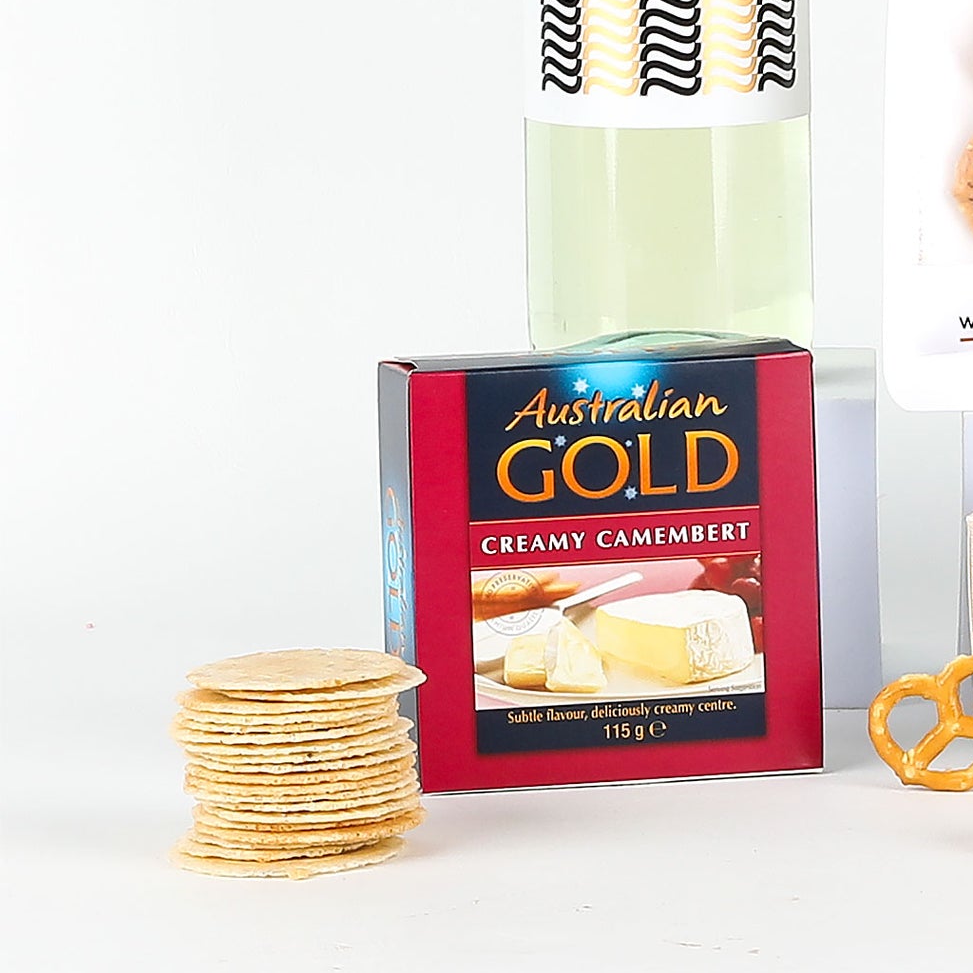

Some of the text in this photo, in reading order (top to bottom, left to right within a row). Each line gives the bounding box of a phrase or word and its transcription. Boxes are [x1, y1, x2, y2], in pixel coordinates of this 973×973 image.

[505, 380, 728, 431] Australian
[497, 430, 739, 503] GOLD
[481, 522, 751, 555] CREAMY CAMEMBERT
[507, 699, 737, 724] Subtle flavour, deliciously creamy centre.
[603, 723, 631, 739] 115
[635, 725, 644, 741] g
